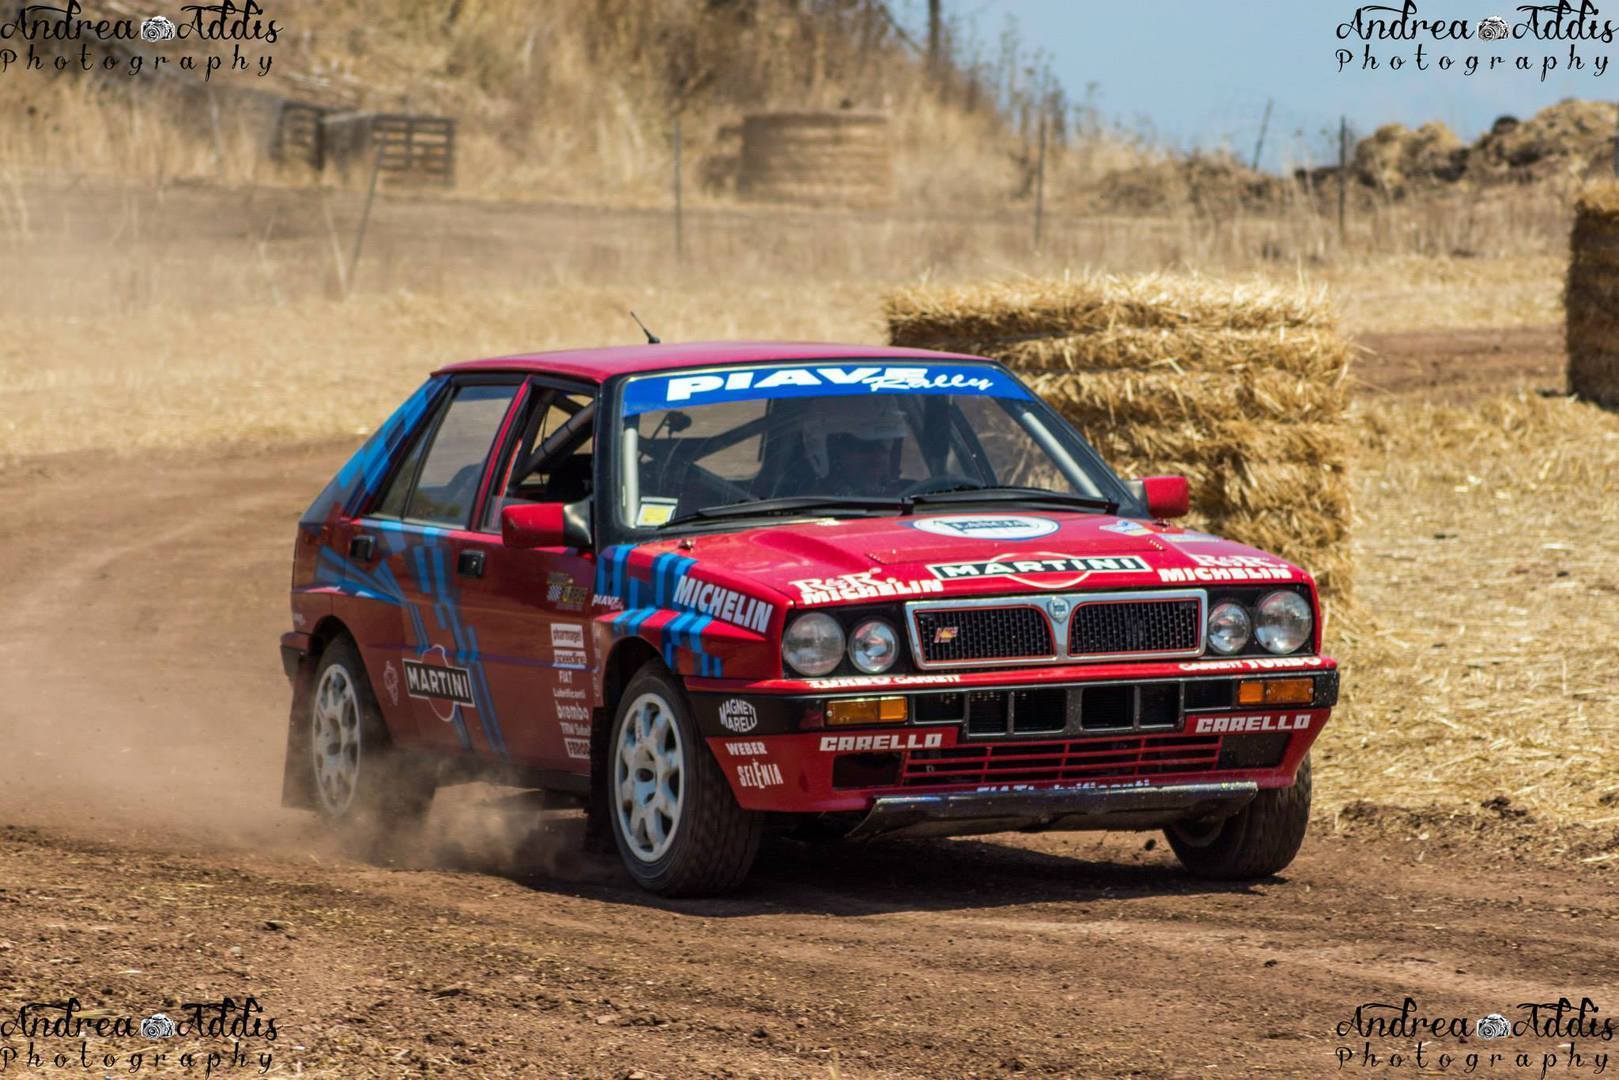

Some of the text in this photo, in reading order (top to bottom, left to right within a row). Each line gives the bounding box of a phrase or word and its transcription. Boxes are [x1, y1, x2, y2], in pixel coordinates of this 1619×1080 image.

[861, 374, 994, 392] Rally
[942, 557, 1138, 577] MARTINI
[1157, 567, 1293, 582] MICHELIN
[800, 578, 945, 605] MICHELIN
[672, 574, 774, 633] MICHELIN
[406, 665, 470, 699] MARTINI
[1195, 714, 1312, 734] CARELLO
[725, 741, 768, 756] WEBER
[819, 733, 943, 752] CARELLO
